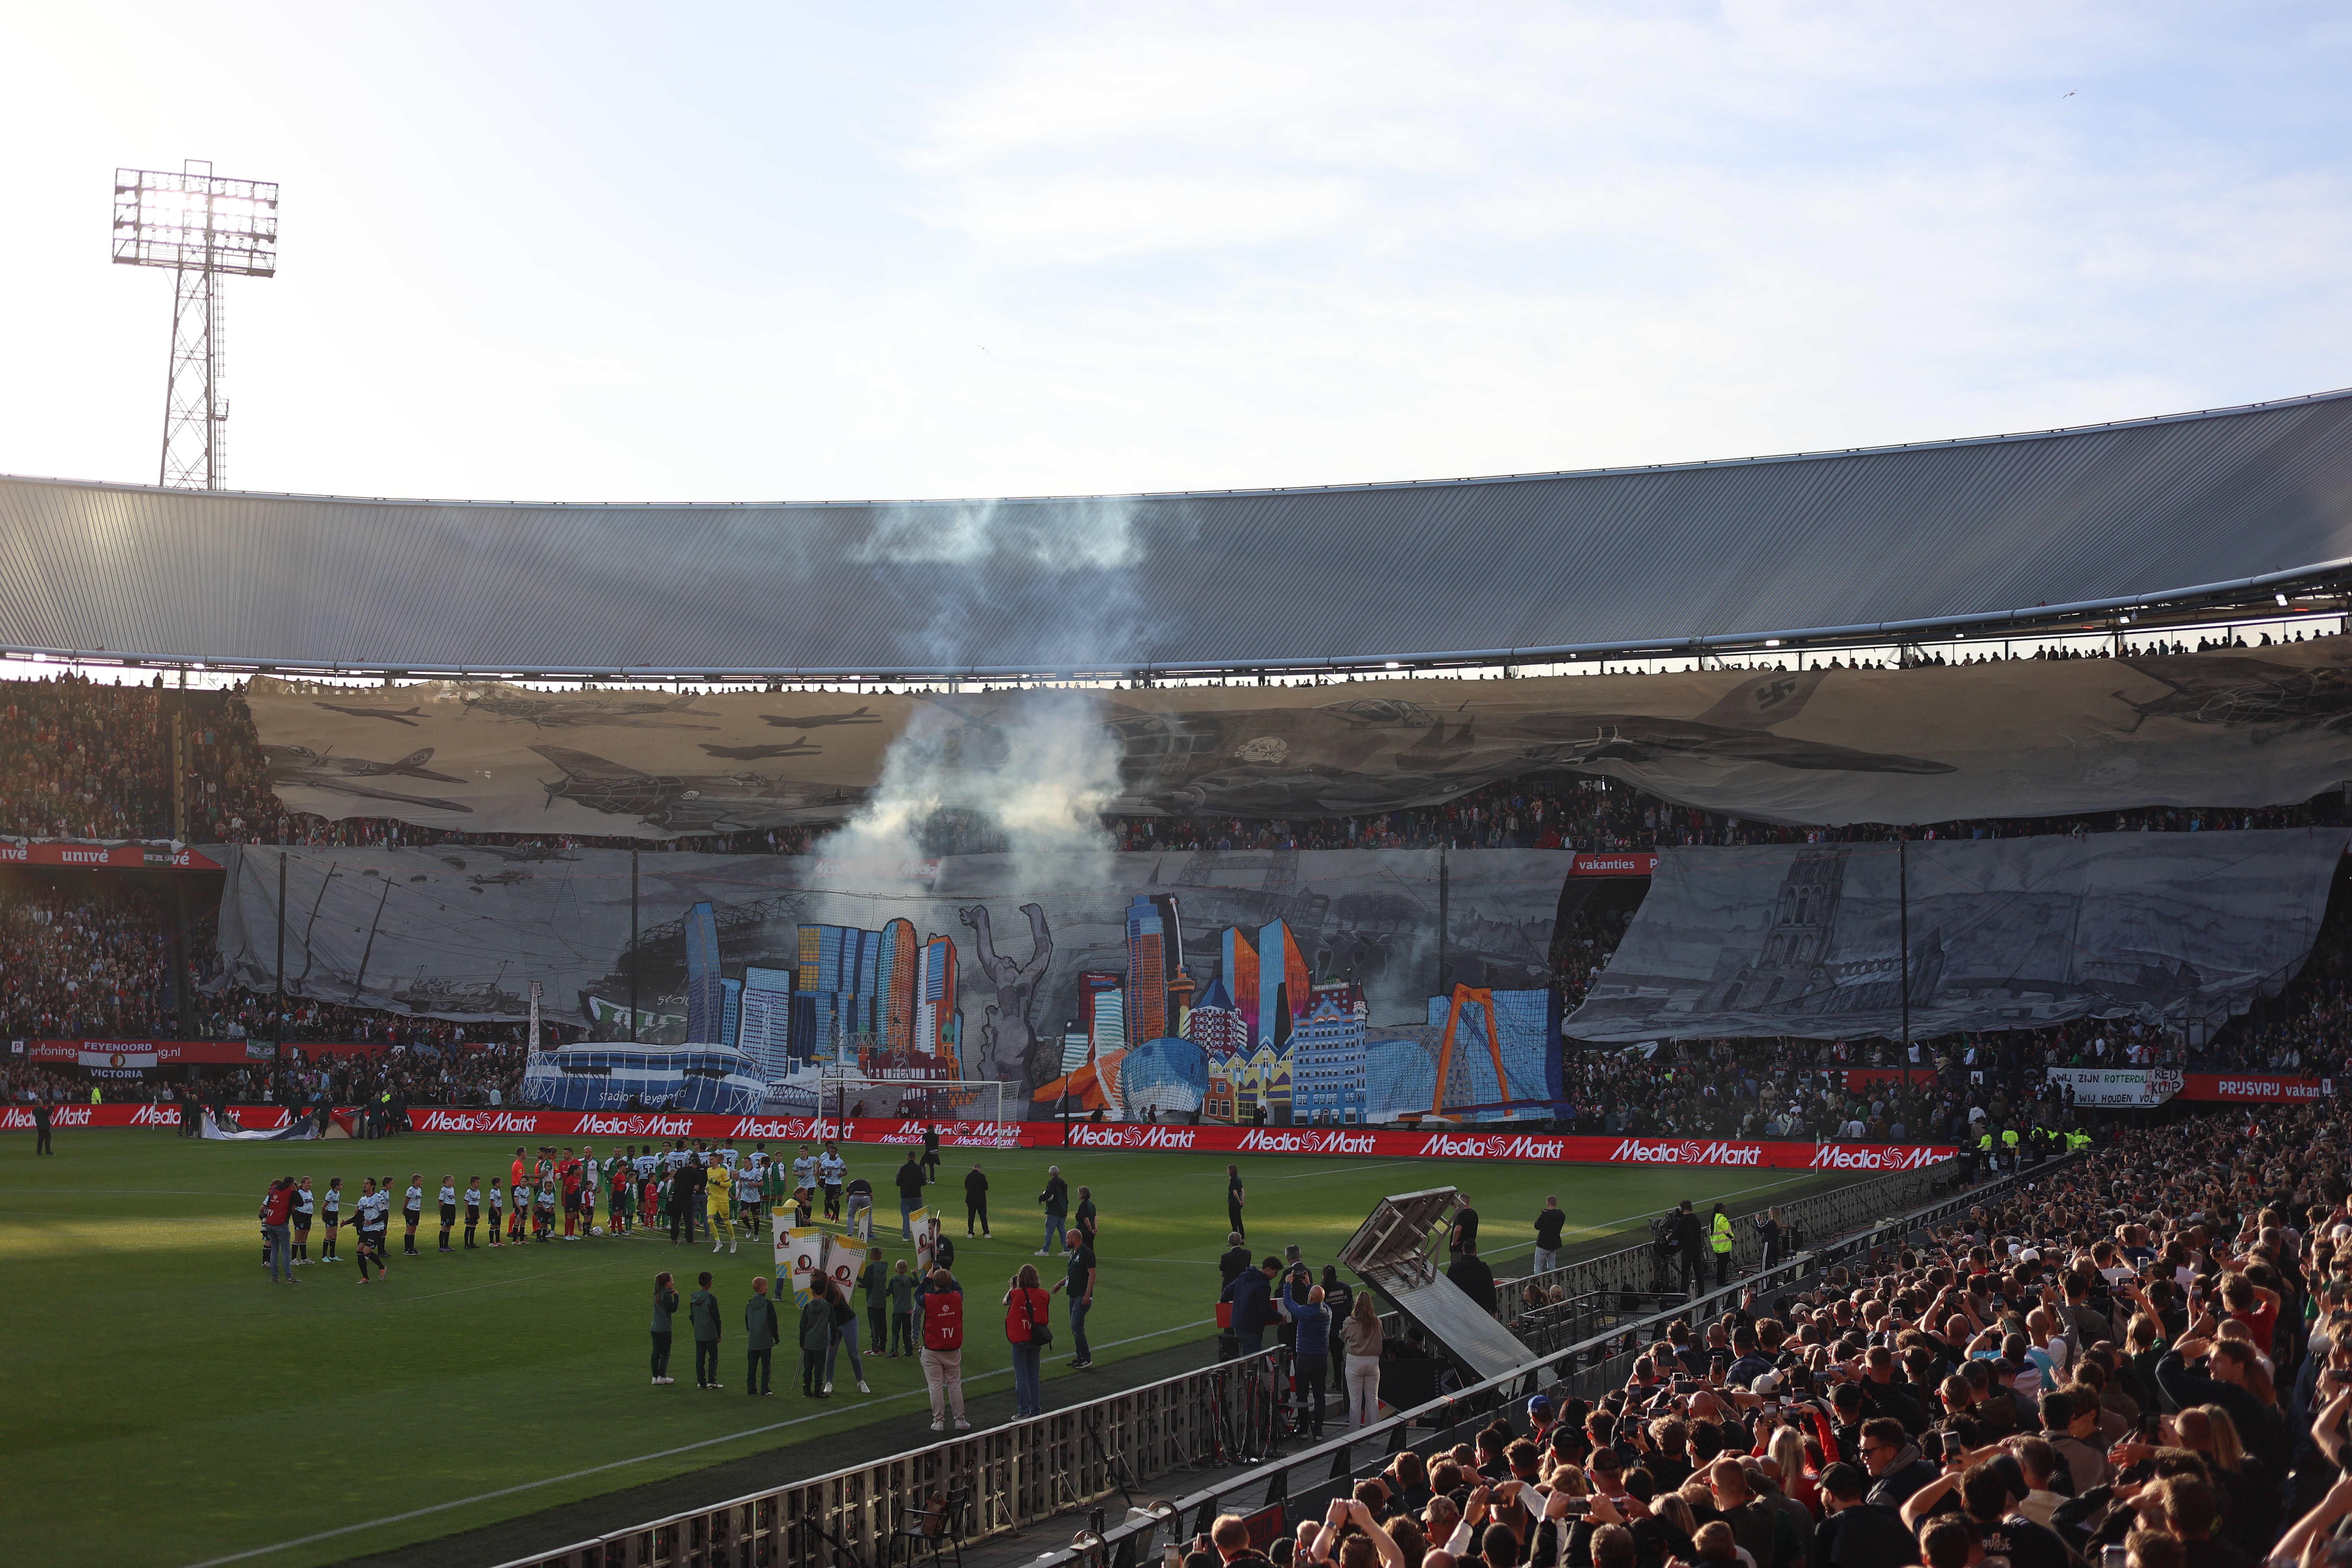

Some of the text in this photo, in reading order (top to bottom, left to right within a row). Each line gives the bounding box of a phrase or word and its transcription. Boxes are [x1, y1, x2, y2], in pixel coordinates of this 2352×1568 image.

[62, 849, 109, 862] univé
[1579, 859, 1634, 869] vakanties
[84, 1042, 152, 1051] FEYENOORD
[90, 1069, 143, 1078] VICTORIA
[2056, 1074, 2145, 1083] WIJ ZIJN ROTTERDA
[2155, 1069, 2178, 1081] RED
[2079, 1094, 2151, 1103] WIJ HOUDEN VOL
[1, 1107, 92, 1128] Medi Markt
[130, 1105, 181, 1124] Media
[421, 1111, 475, 1131] Media
[488, 1112, 537, 1132] Markt
[573, 1114, 693, 1135] Media Markt
[730, 1117, 788, 1137] Media
[879, 1134, 907, 1143] Media
[953, 1136, 982, 1145] Media
[1062, 1125, 1196, 1148] Media Markt
[1237, 1129, 1376, 1153] Media Markt
[1419, 1134, 1564, 1159] Media Markt
[1609, 1139, 1762, 1165] Media Markt
[727, 1157, 732, 1167] 6
[1808, 1145, 1882, 1169] Media
[643, 1163, 654, 1174] 52
[673, 1160, 683, 1170] 19
[1022, 1319, 1032, 1330] TV
[942, 1327, 954, 1338] TV
